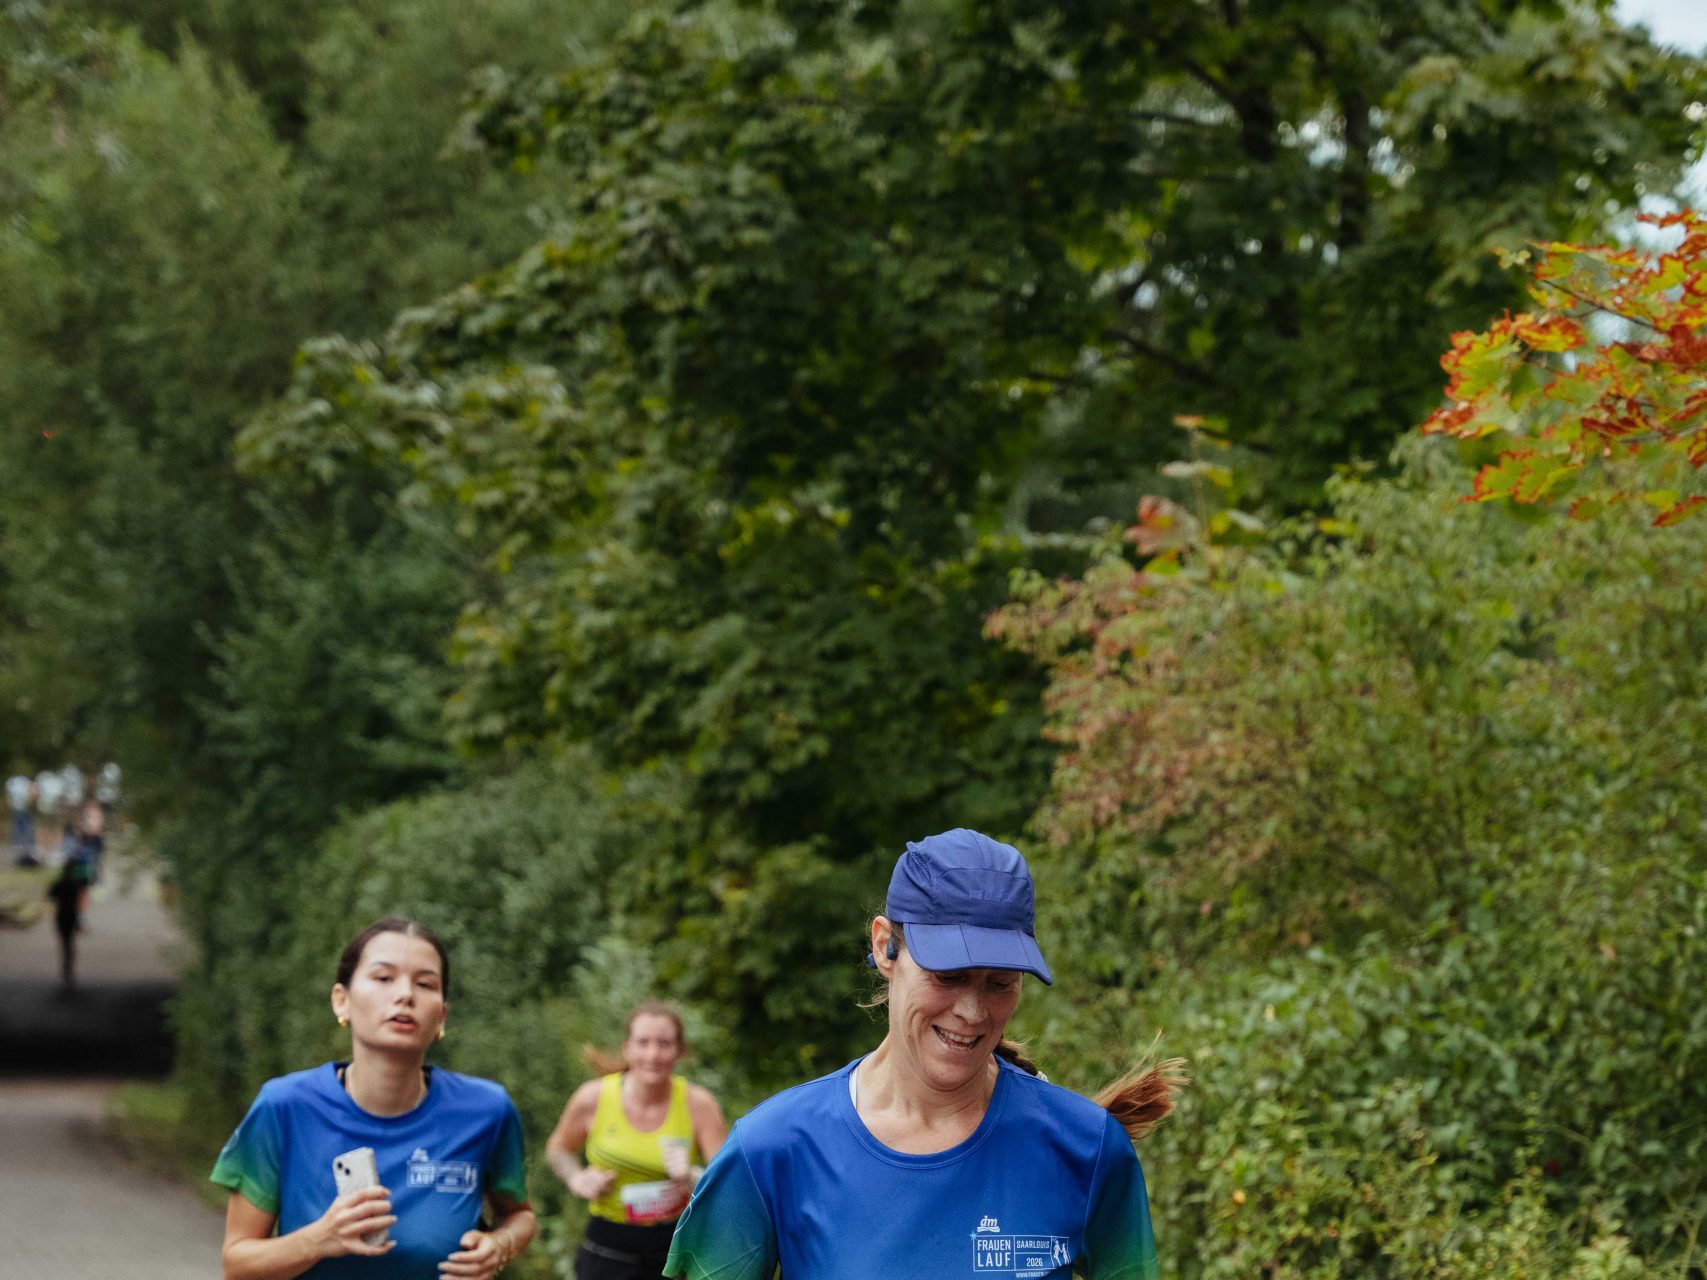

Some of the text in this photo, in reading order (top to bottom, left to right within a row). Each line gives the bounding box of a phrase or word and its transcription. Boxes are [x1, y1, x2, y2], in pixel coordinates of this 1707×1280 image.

[980, 1215, 998, 1227] dm
[977, 1239, 1011, 1251] FRAUEN
[1016, 1240, 1050, 1249] SAARLOUIS
[977, 1252, 1011, 1268] LAUF
[1026, 1257, 1044, 1267] 2026
